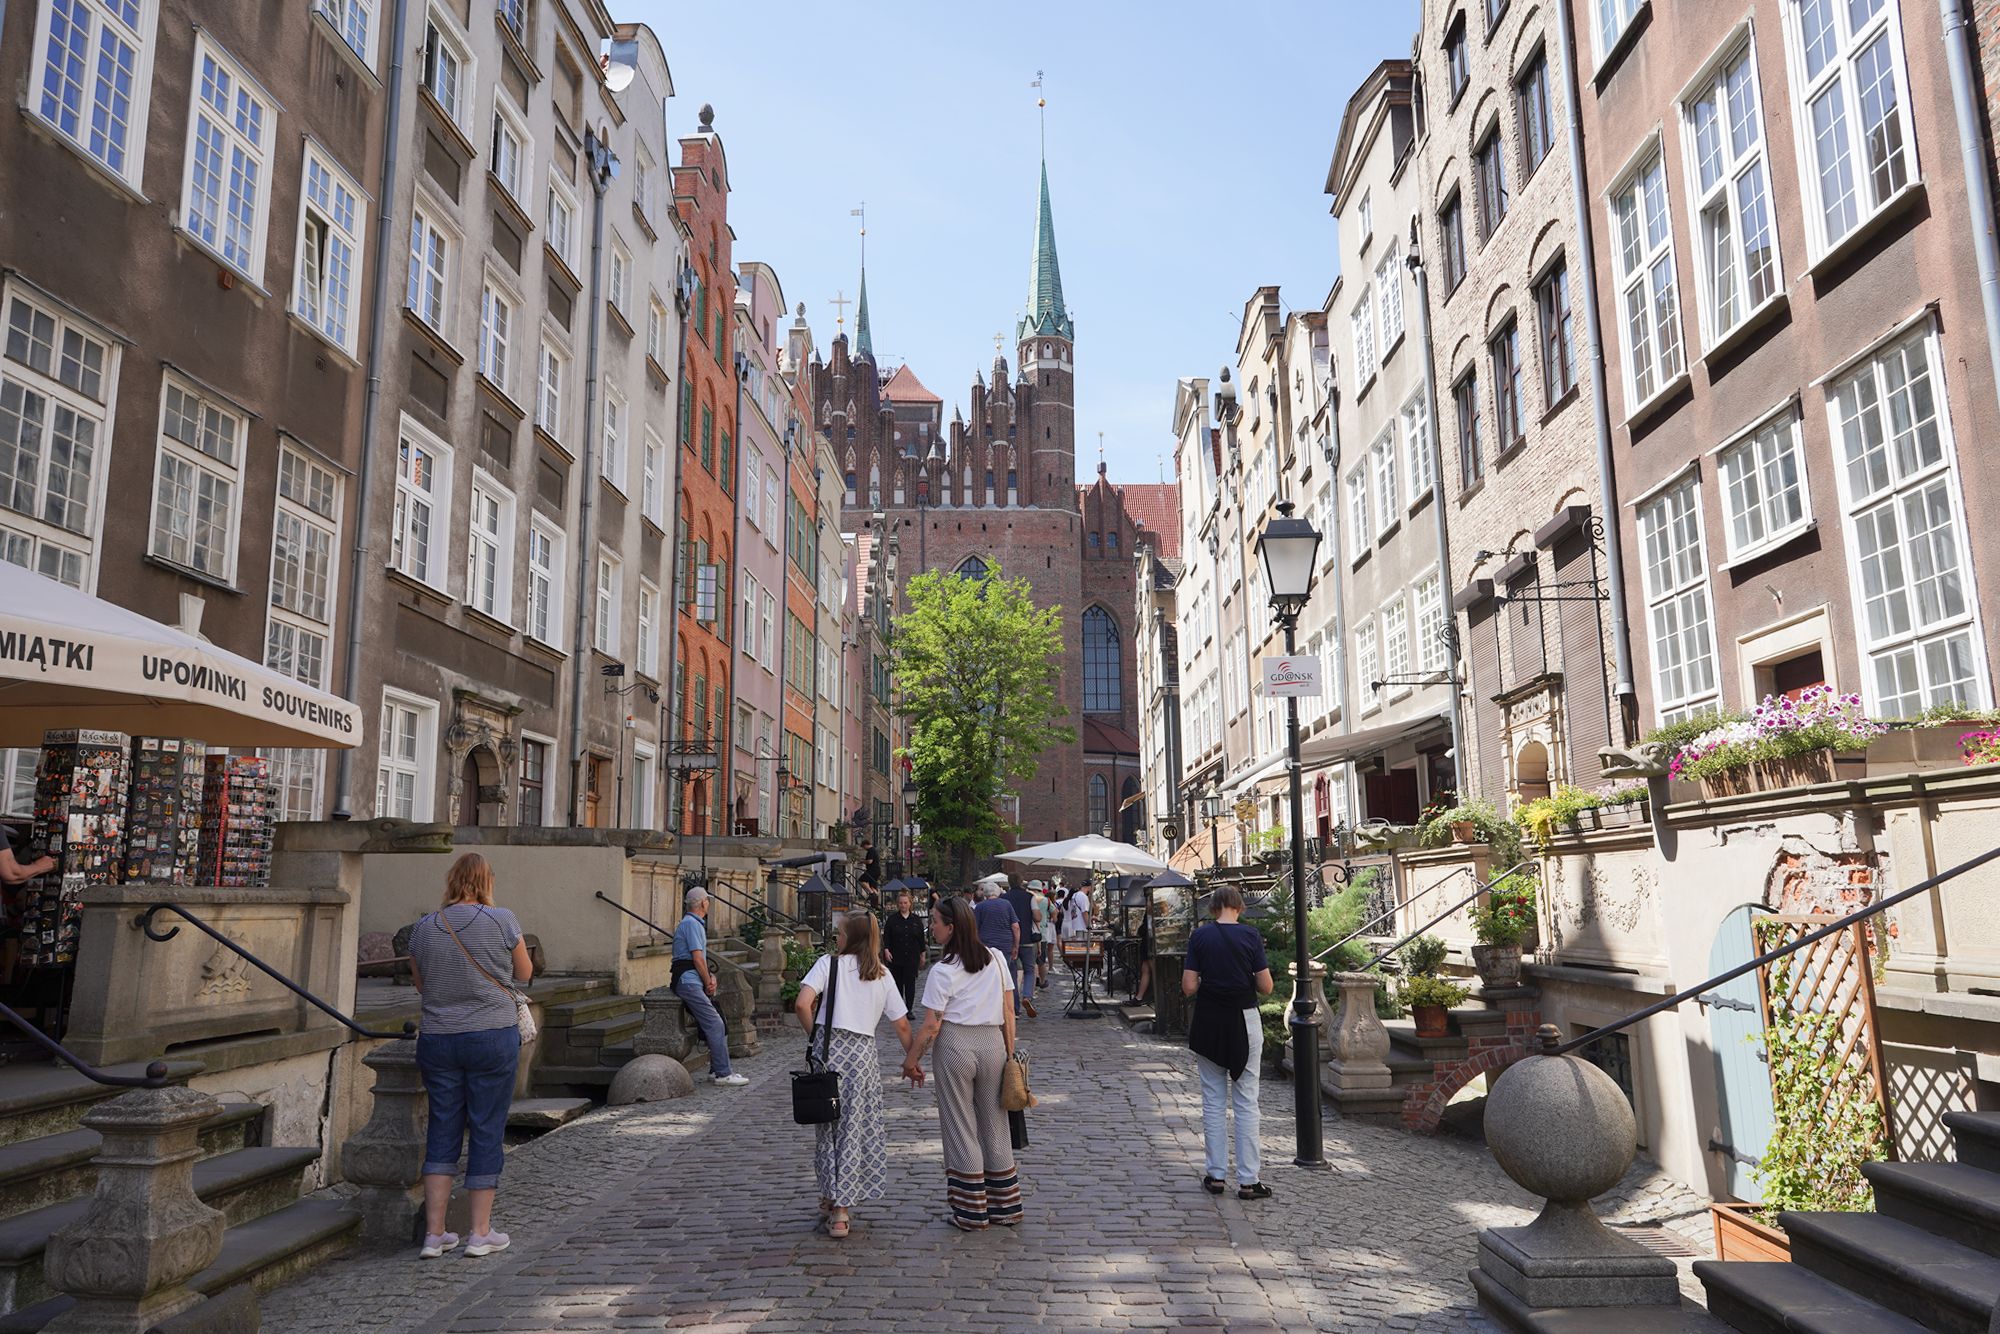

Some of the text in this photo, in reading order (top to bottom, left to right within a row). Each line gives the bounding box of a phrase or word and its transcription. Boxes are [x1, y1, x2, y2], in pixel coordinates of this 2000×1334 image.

[0, 630, 353, 733] MIĄTKI UPOMINKI SOUVENIRS
